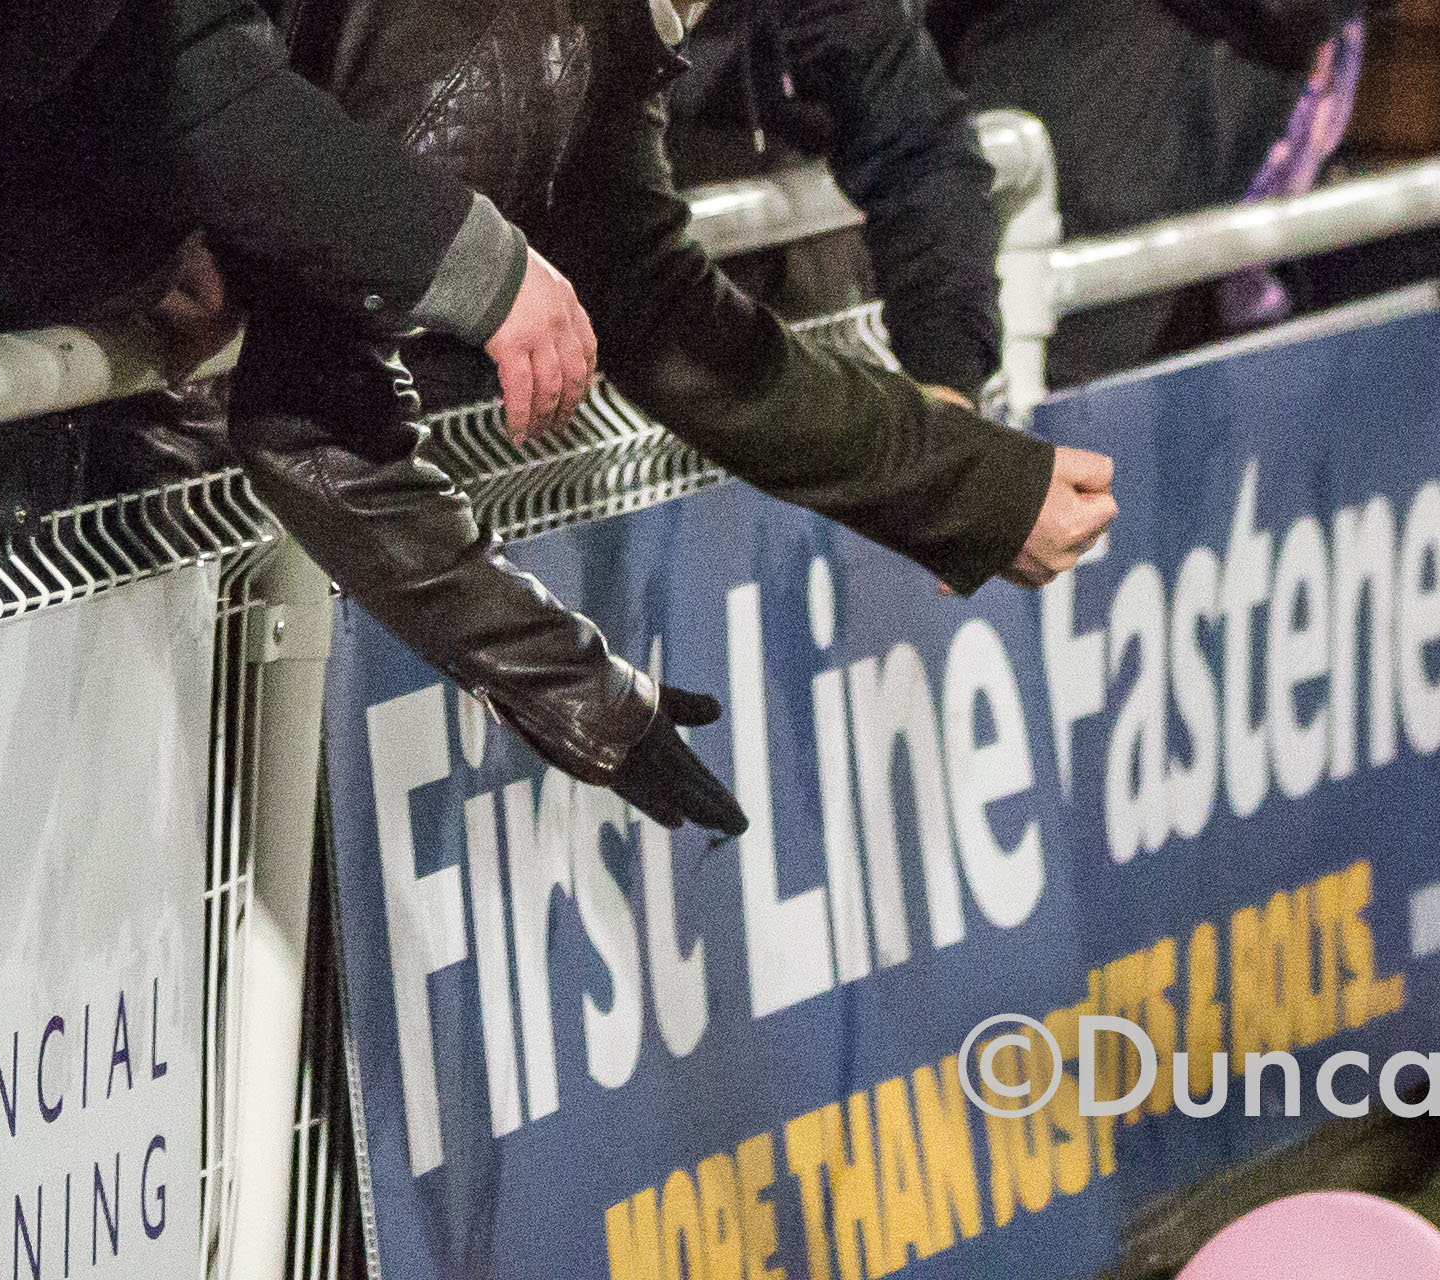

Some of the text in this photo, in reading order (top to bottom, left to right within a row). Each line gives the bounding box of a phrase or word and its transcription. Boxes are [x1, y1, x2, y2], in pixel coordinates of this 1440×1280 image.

[366, 635, 710, 1178] First
[726, 555, 1046, 1020] Line
[785, 1053, 983, 1280] THAN
